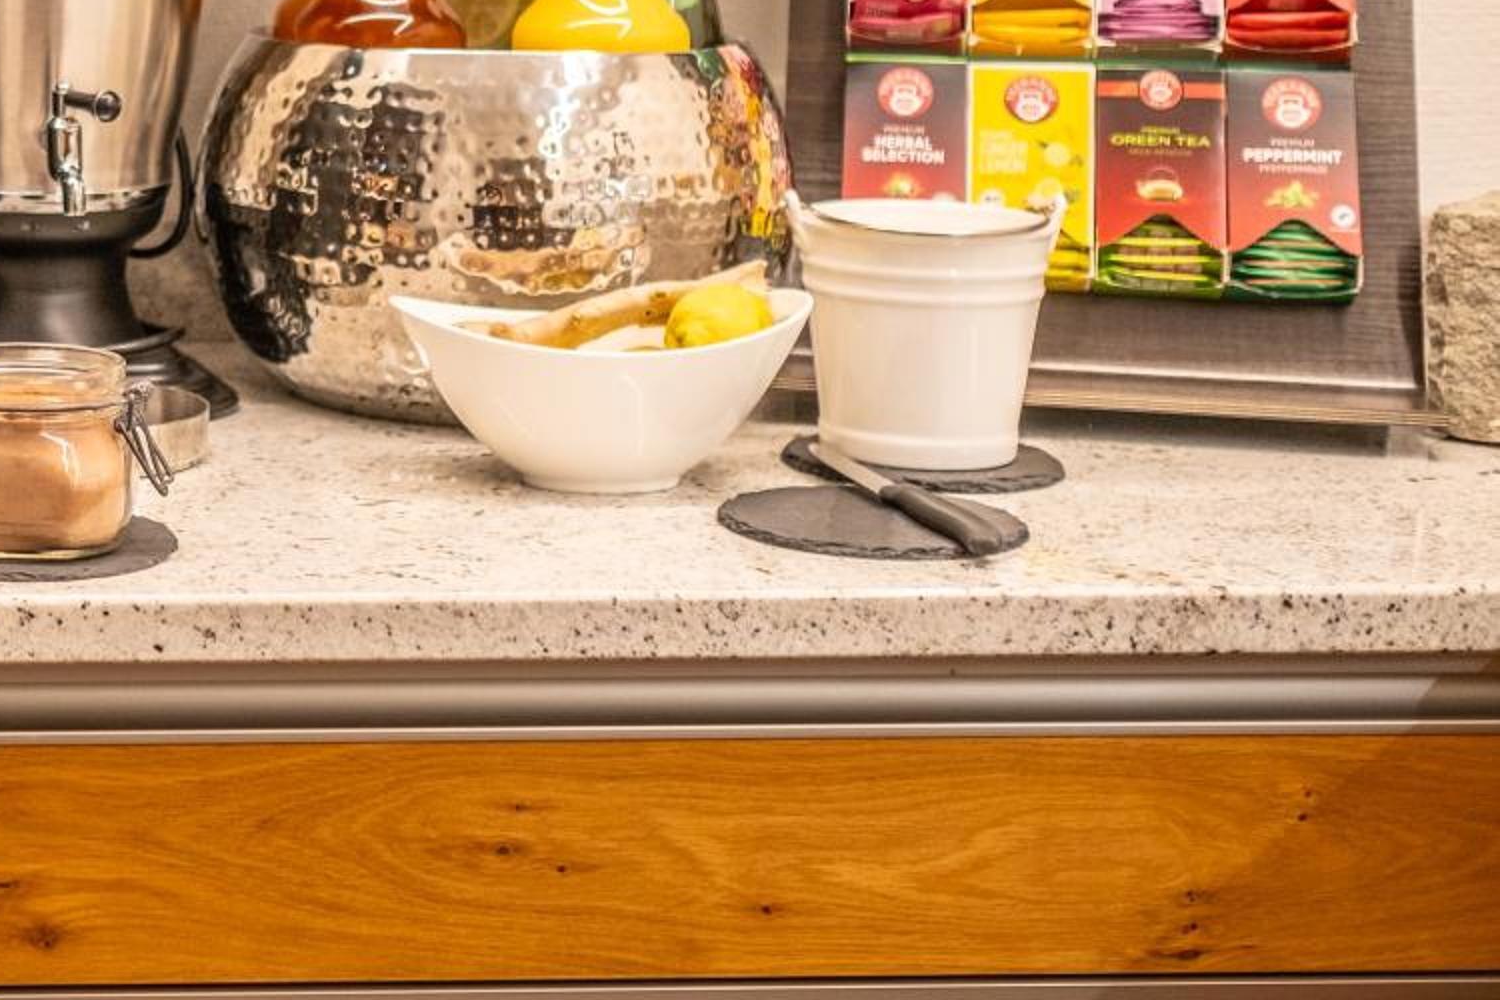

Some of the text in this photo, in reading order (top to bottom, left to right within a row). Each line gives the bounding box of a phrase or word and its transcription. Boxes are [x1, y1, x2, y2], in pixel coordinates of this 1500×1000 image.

[874, 135, 933, 151] HERBAL
[1110, 132, 1211, 148] GREEN TEA
[861, 147, 946, 165] SELECTION
[1242, 147, 1343, 165] PEPPERMINT
